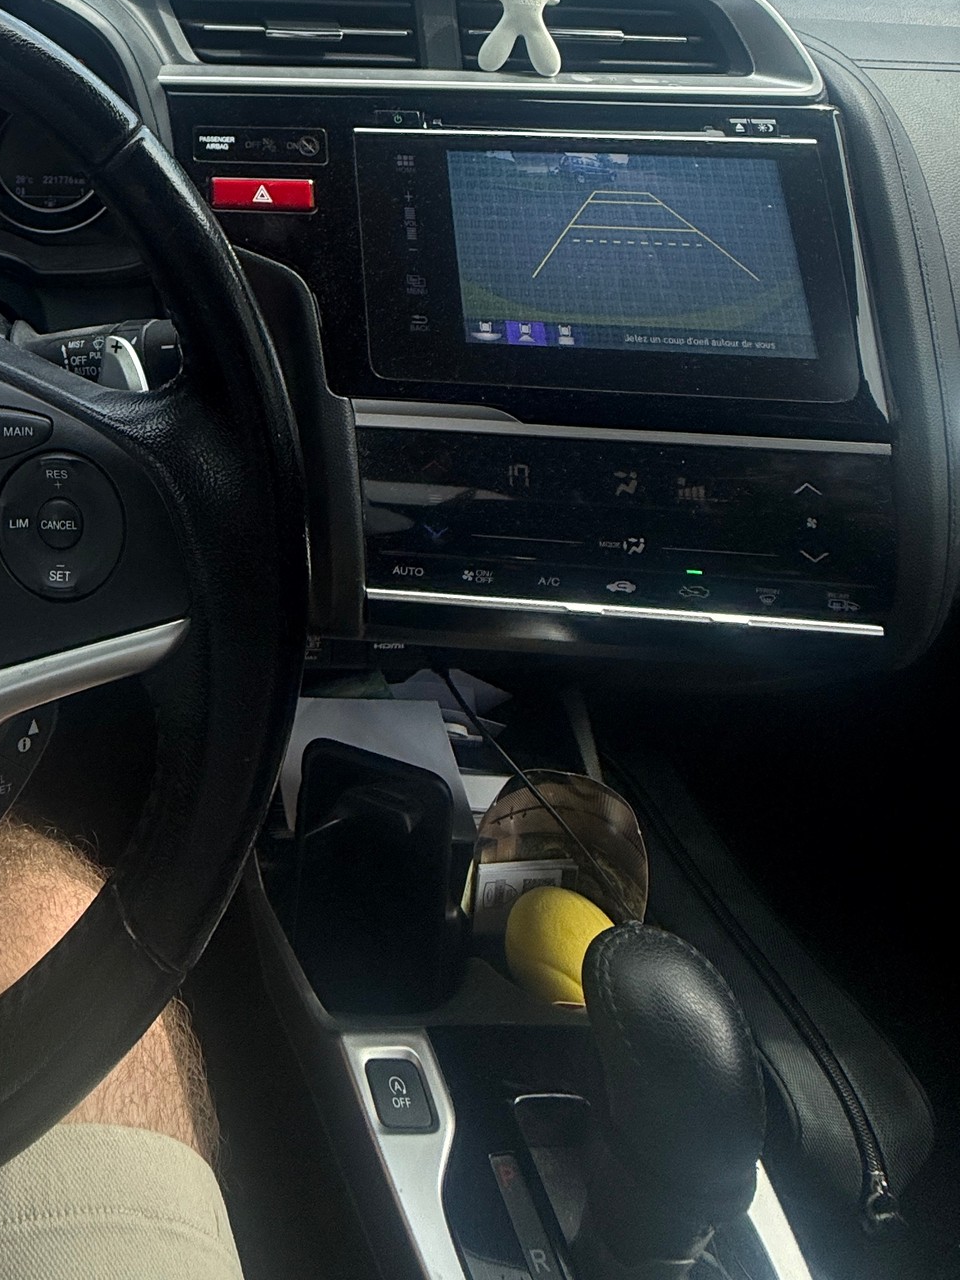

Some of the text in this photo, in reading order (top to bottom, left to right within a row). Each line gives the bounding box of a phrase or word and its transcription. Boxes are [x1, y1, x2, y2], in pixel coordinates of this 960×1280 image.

[68, 340, 85, 349] MIST
[625, 333, 649, 343] Jetez
[650, 336, 661, 344] un
[663, 337, 685, 346] coup
[711, 338, 739, 348] autour
[741, 339, 752, 348] de
[754, 341, 776, 350] vous
[70, 355, 87, 365] OFF
[89, 352, 102, 360] PUL
[3, 427, 33, 437] MAIN
[46, 470, 68, 479] RES
[9, 518, 29, 529] LIM
[40, 520, 77, 530] CANCEL
[49, 571, 71, 582] SET
[392, 565, 424, 577] AUTO
[538, 576, 560, 587] A/C
[392, 1097, 412, 1109] OFF
[529, 1248, 551, 1274] R
